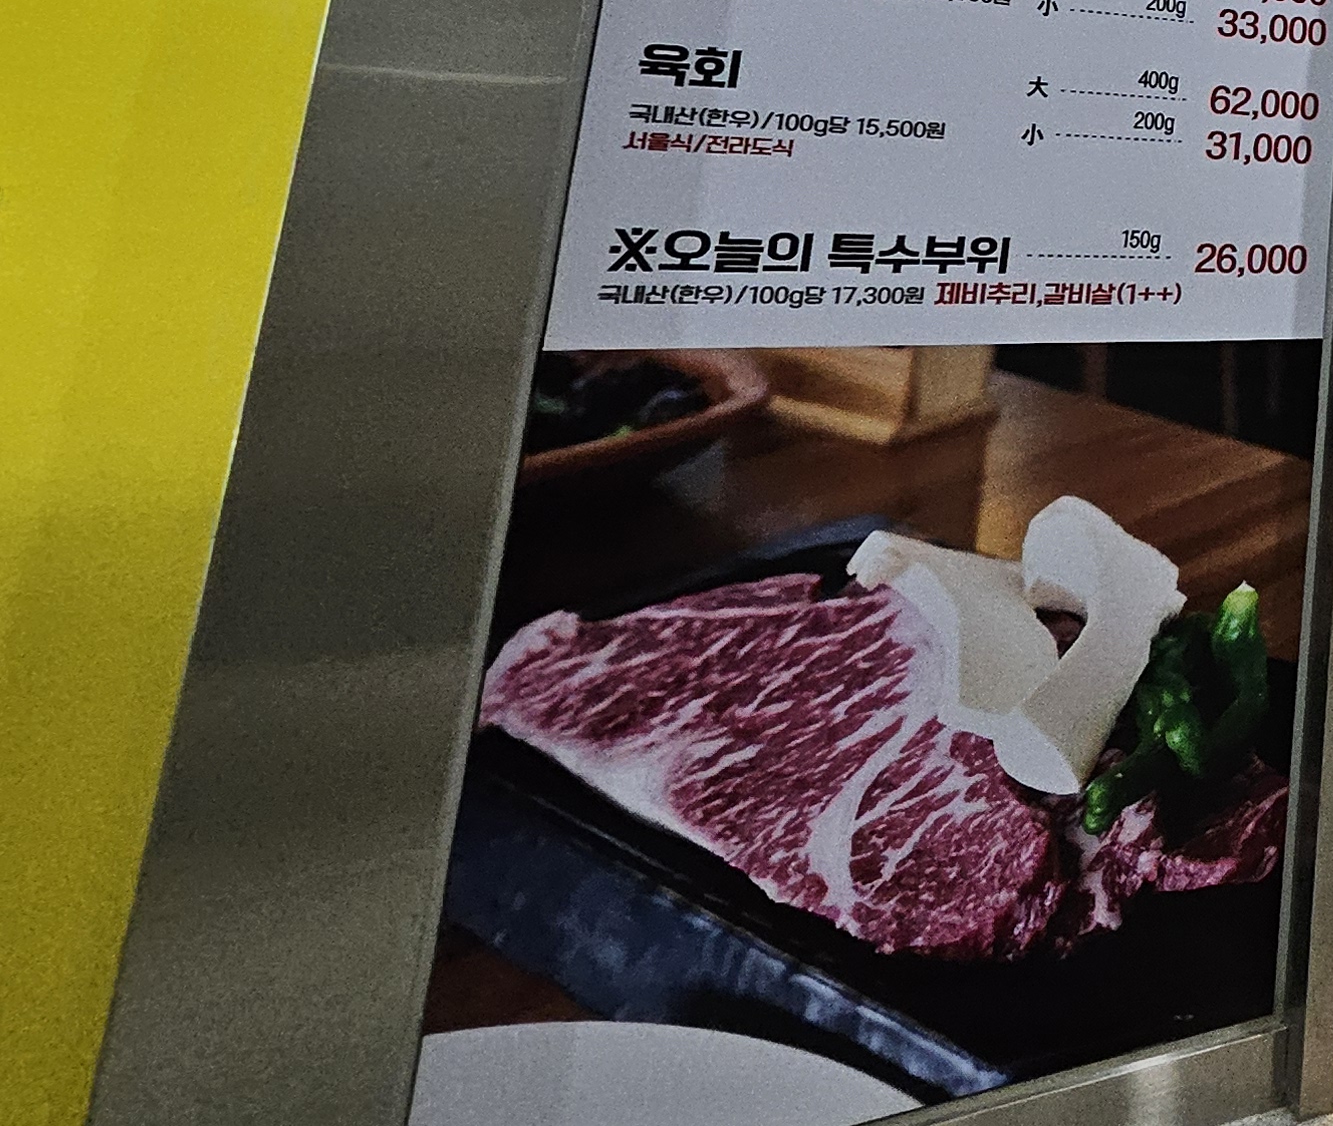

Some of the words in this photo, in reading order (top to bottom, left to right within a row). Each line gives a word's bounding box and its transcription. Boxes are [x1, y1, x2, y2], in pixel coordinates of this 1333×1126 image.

[1217, 8, 1327, 47] 33,000
[638, 43, 743, 90] 육회
[1026, 76, 1049, 99] 大
[1138, 70, 1179, 95] 400g
[1209, 85, 1320, 122] 62,000
[622, 130, 795, 158] 서울식/전라도식
[856, 116, 946, 140] 15,500원
[1021, 123, 1044, 147] 小
[1133, 110, 1176, 136] 200g
[1205, 129, 1312, 165] 31,000
[827, 232, 1011, 275] 특수부위
[1121, 229, 1162, 253] 150g
[1194, 243, 1308, 277] 26,000
[831, 285, 925, 307] 17,300원
